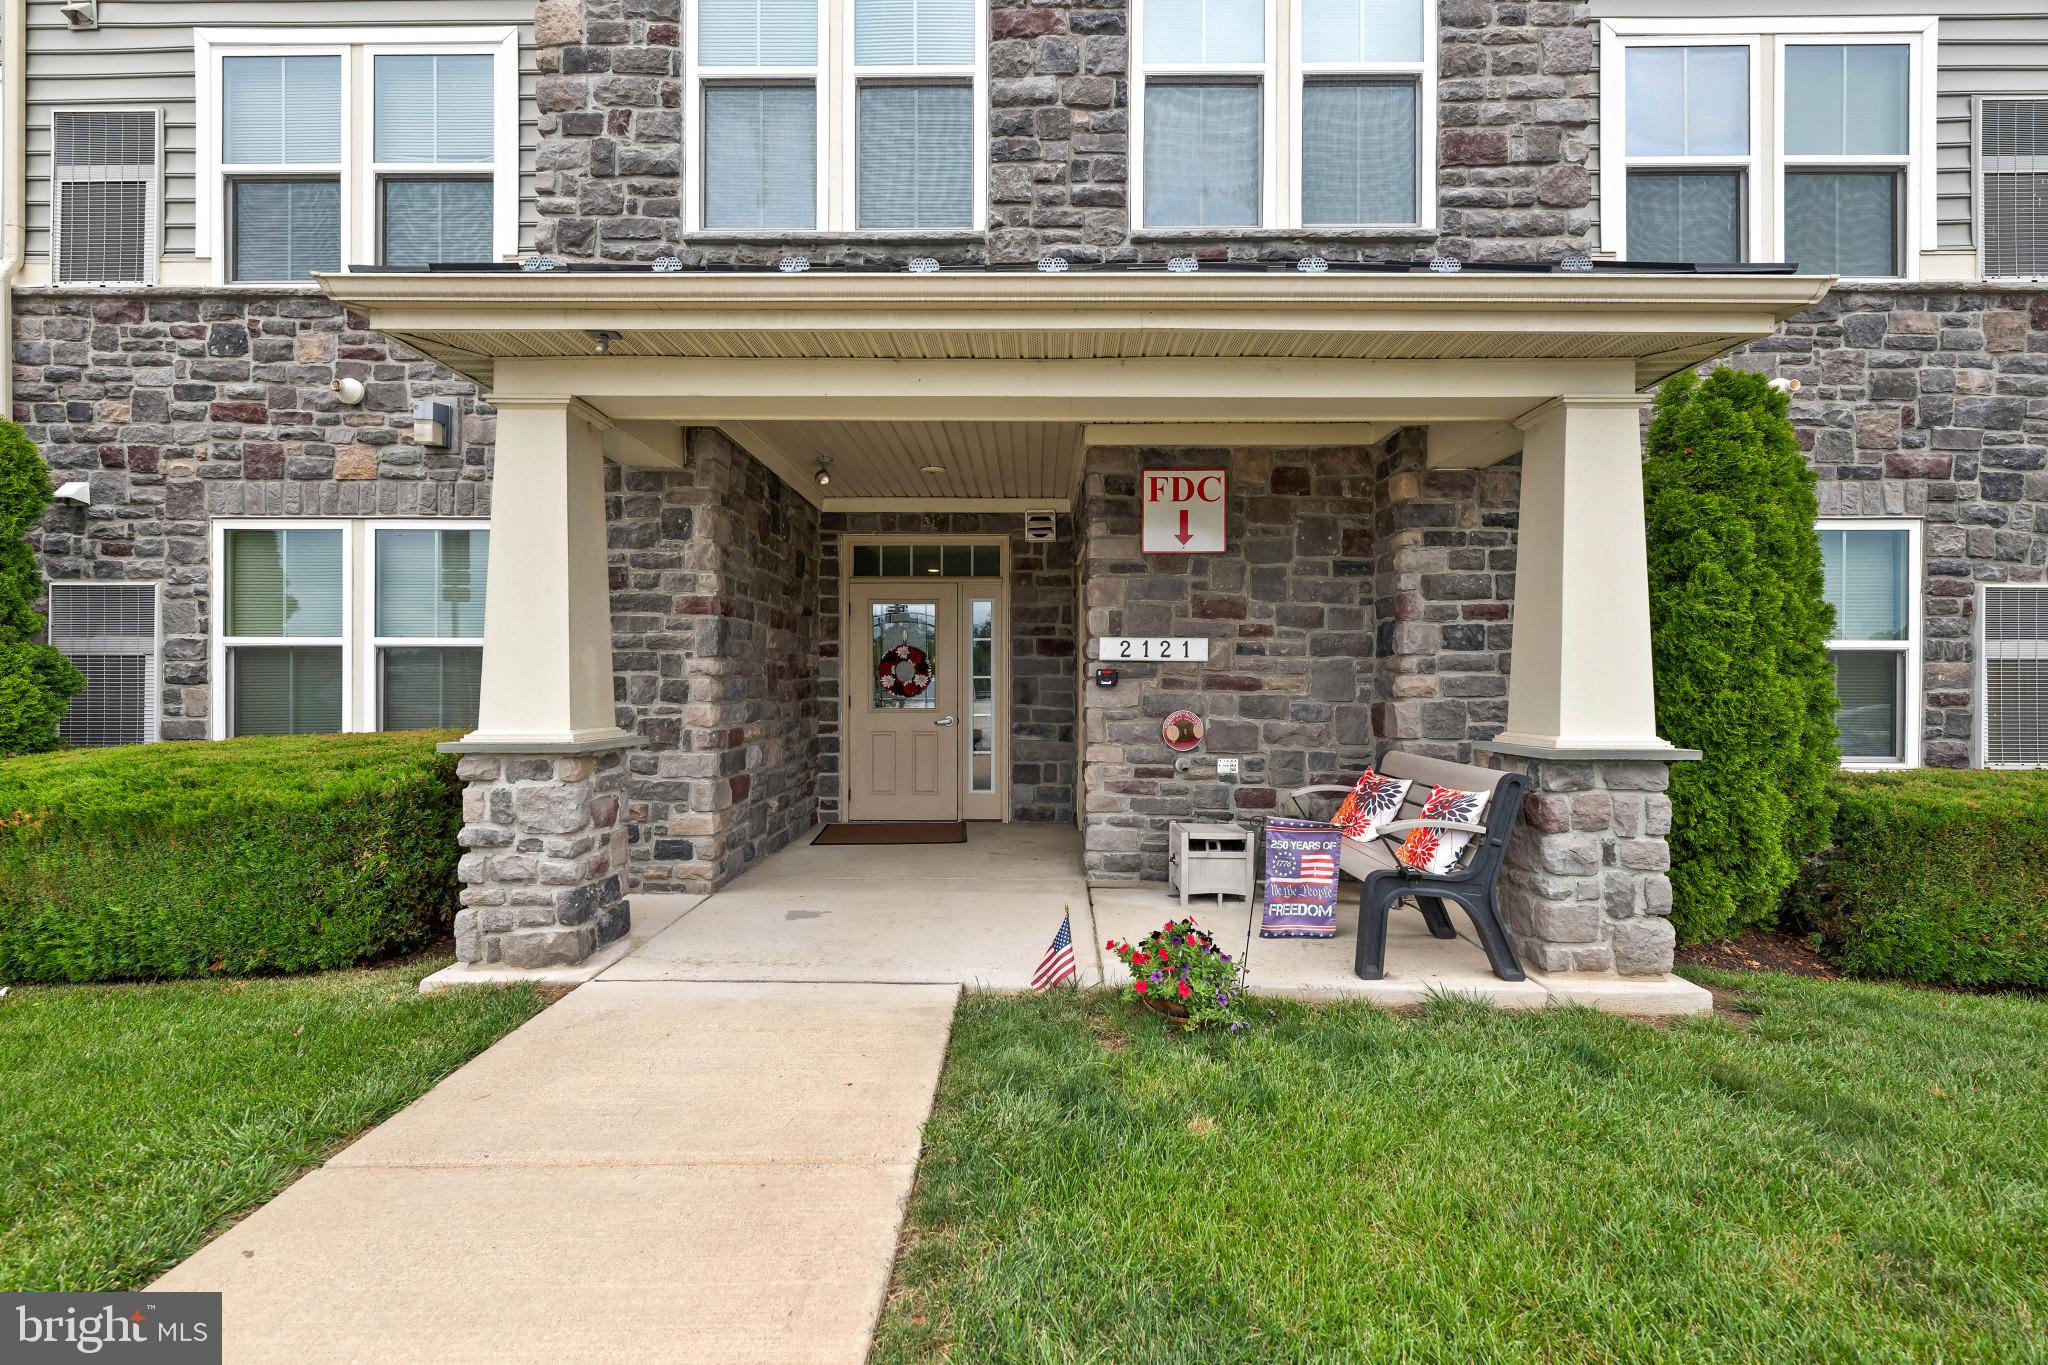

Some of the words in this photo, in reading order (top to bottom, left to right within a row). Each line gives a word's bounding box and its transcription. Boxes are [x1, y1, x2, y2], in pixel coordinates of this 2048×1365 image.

[1148, 476, 1221, 503] FDC
[1120, 640, 1189, 658] 2121
[1271, 840, 1289, 850] 250
[1291, 841, 1321, 850] YEARS
[1323, 842, 1337, 850] OF
[1276, 860, 1292, 868] 1776
[1270, 883, 1281, 896] We
[1283, 884, 1297, 898] the
[1299, 884, 1332, 900] People
[1268, 903, 1333, 917] FREEDOM
